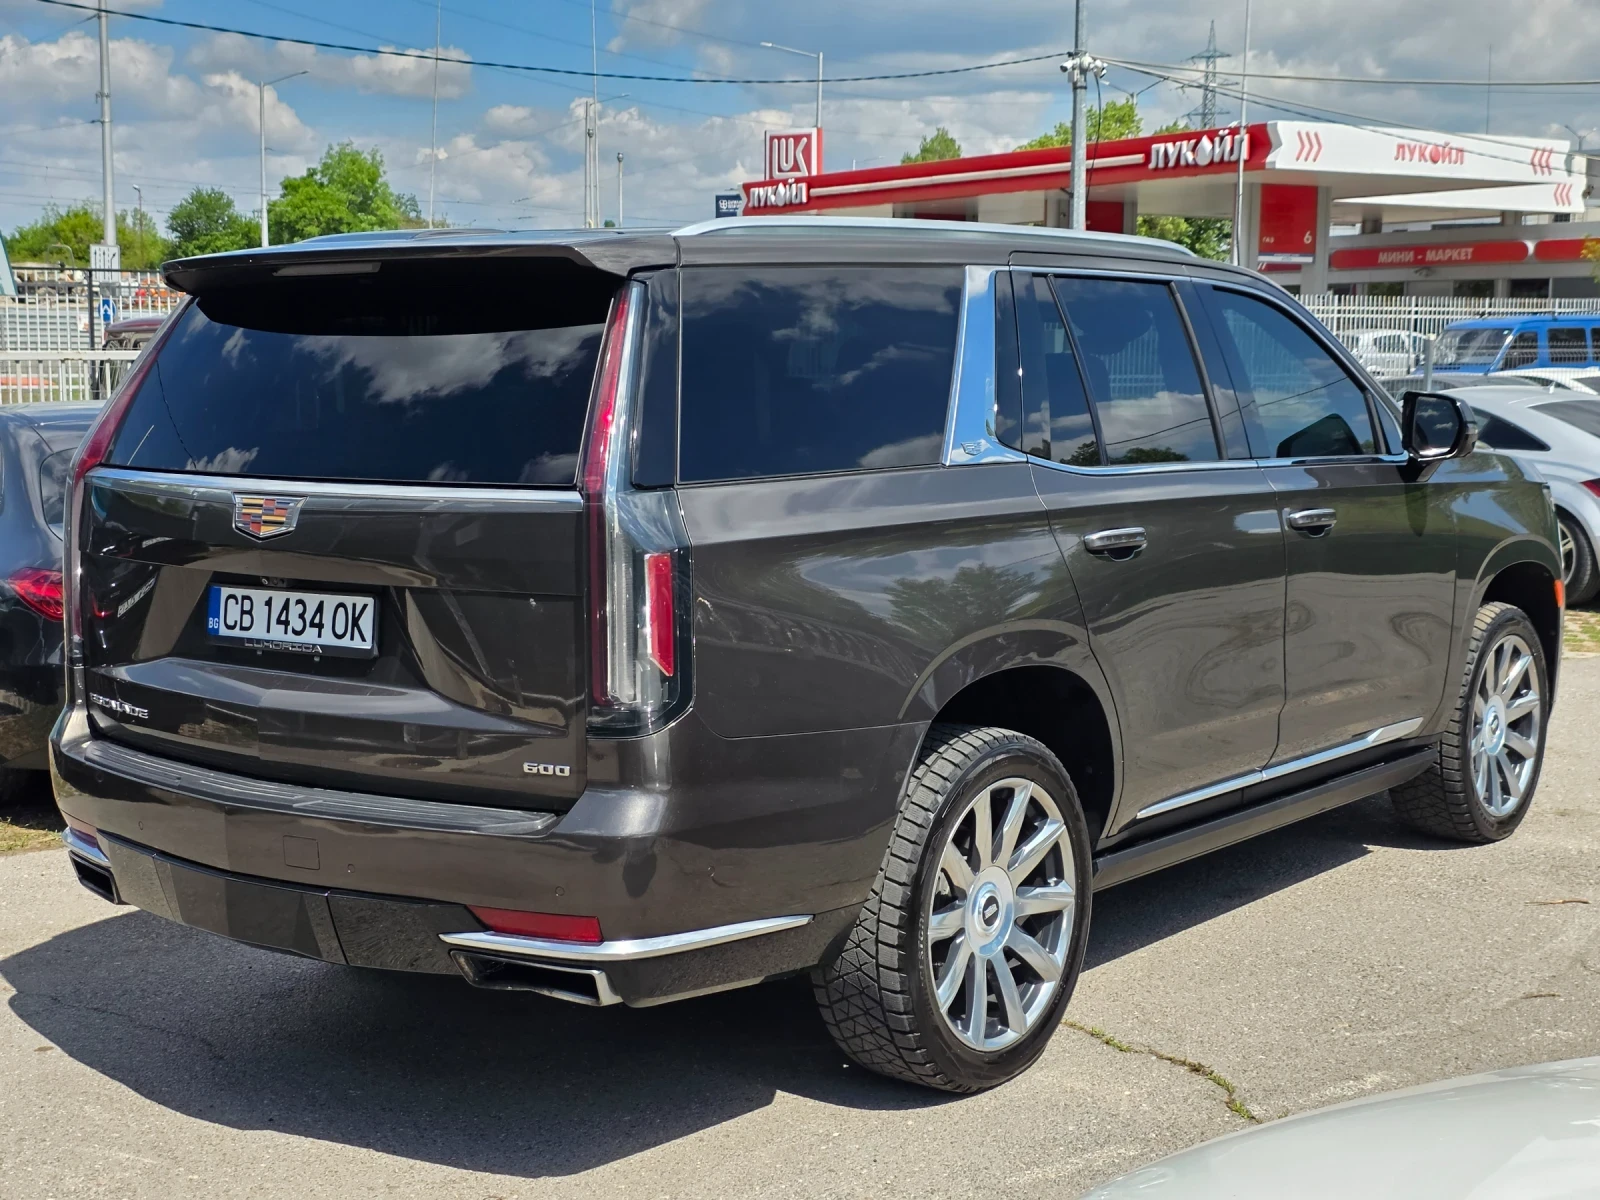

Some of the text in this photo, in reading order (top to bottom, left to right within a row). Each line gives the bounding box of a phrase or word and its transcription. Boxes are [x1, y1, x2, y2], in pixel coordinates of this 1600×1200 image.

[1394, 141, 1465, 165] ЛУКОЙЛ
[1303, 230, 1313, 245] 6
[1378, 250, 1415, 264] МИНИ
[1425, 247, 1475, 262] МАРКЕТ
[208, 593, 369, 642] BG CB 1434 OK
[523, 761, 570, 777] 600
